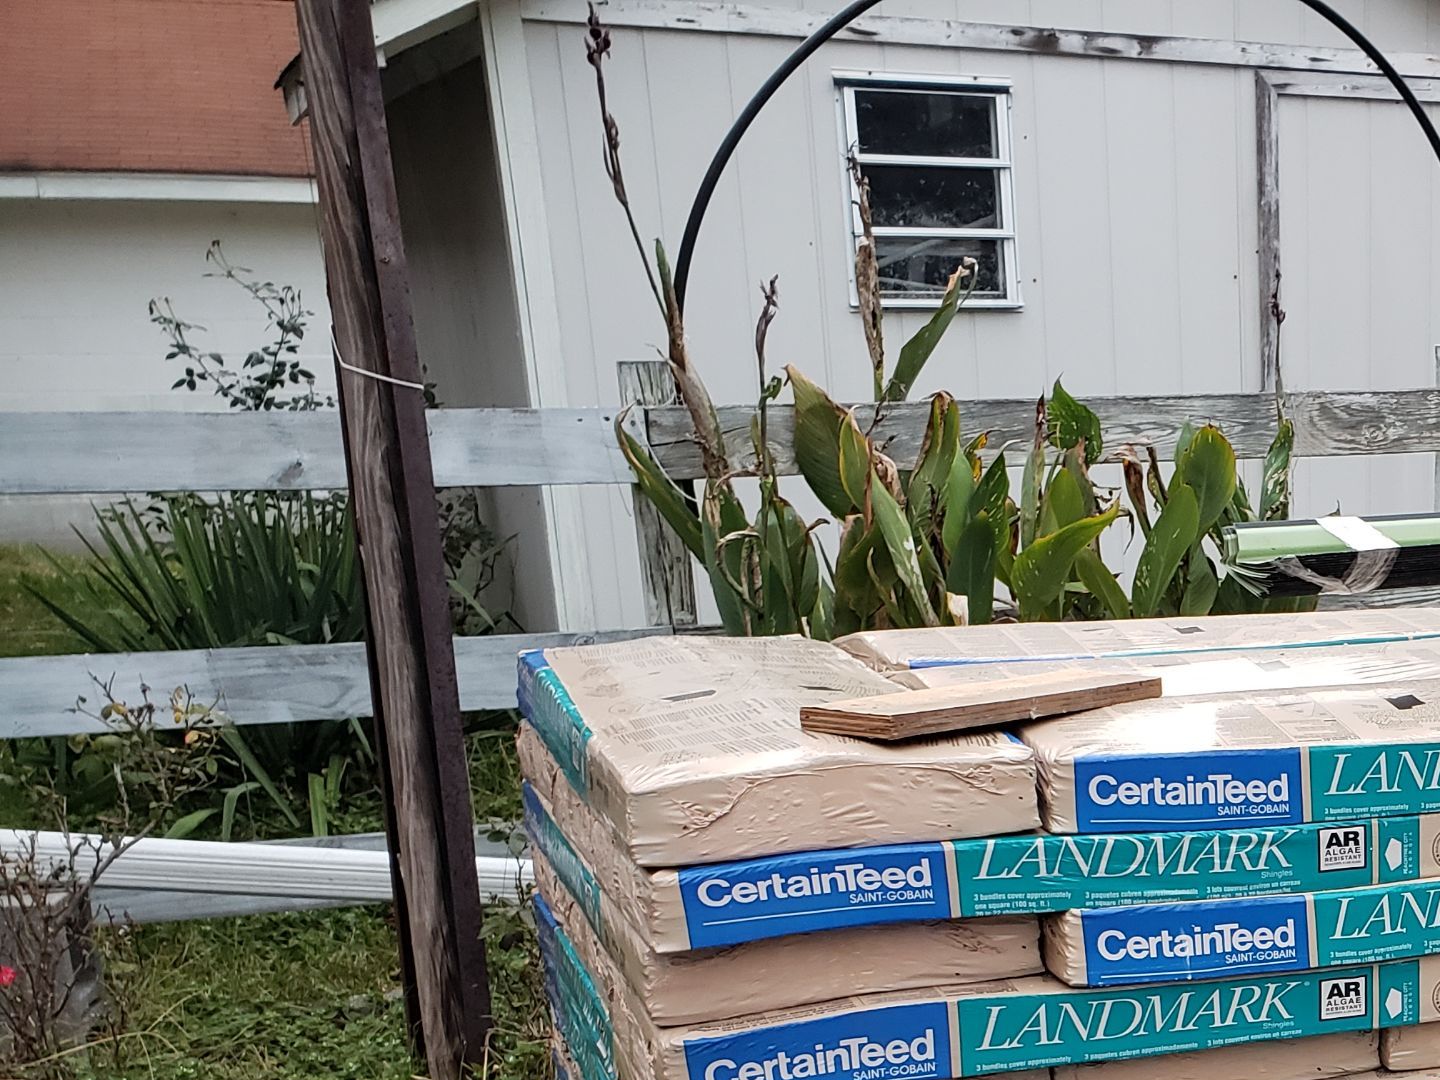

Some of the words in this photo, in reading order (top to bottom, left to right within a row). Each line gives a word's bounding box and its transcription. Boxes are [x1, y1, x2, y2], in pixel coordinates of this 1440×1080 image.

[1088, 773, 1289, 806] CertainTeed
[1217, 803, 1289, 816] SAINT-GOBAIN
[1325, 831, 1360, 848] AR
[973, 828, 1300, 880] LANDMARK
[1324, 847, 1365, 856] ALGAE
[1324, 854, 1362, 862] RESISTANT
[1261, 870, 1293, 879] Shingles
[697, 858, 932, 907] CertainTeed
[849, 889, 934, 904] SAINT-GOBAIN
[1097, 919, 1295, 961] CertainTeed
[1225, 949, 1296, 964] SAINT-GOBAIN
[1327, 981, 1361, 999] AR
[1325, 1004, 1362, 1013] RESISTANT
[1326, 997, 1362, 1007] ALGAE
[976, 981, 1301, 1051] LANDMARK
[1262, 1020, 1294, 1031] Shingles
